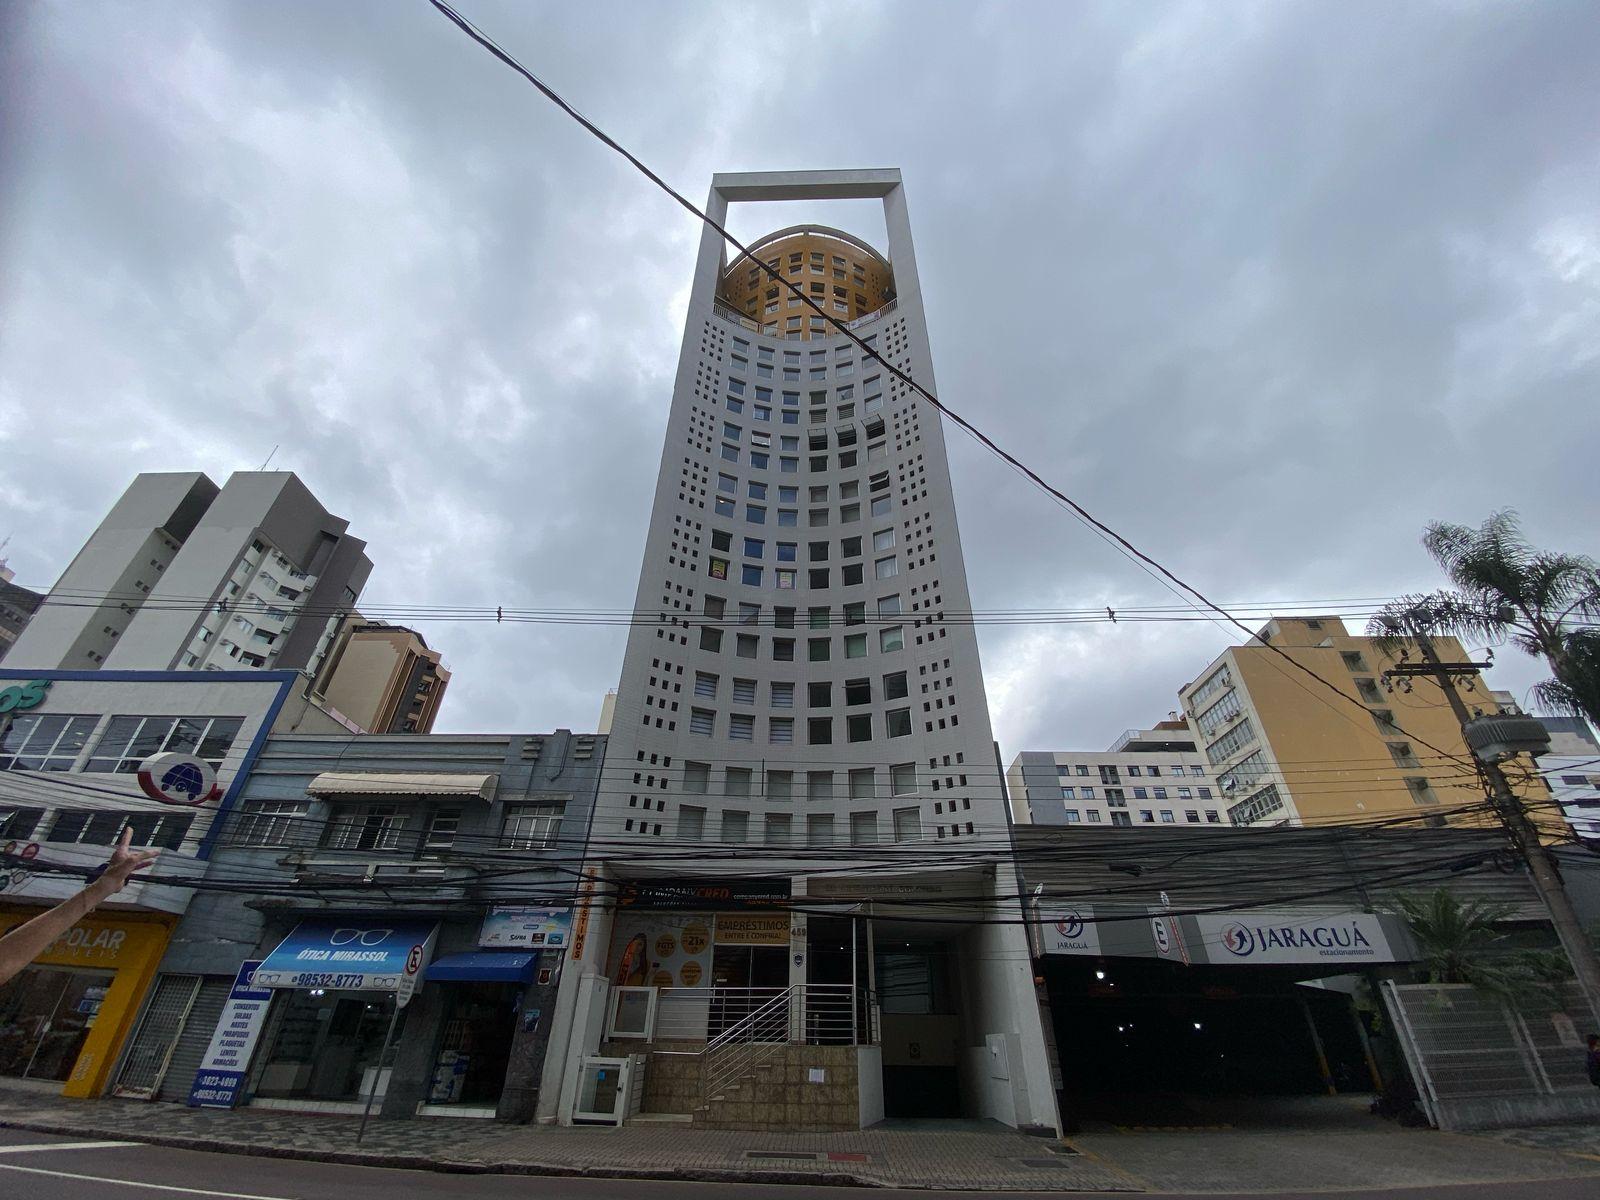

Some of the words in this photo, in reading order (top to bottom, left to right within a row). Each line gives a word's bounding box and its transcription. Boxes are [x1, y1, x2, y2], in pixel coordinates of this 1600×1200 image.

[1256, 920, 1370, 952] JARAGUÁ
[297, 947, 328, 961] ÓTICA
[330, 949, 389, 962] MIRASSOL
[1318, 947, 1375, 957] estacionamento
[297, 973, 364, 988] 98532-8773
